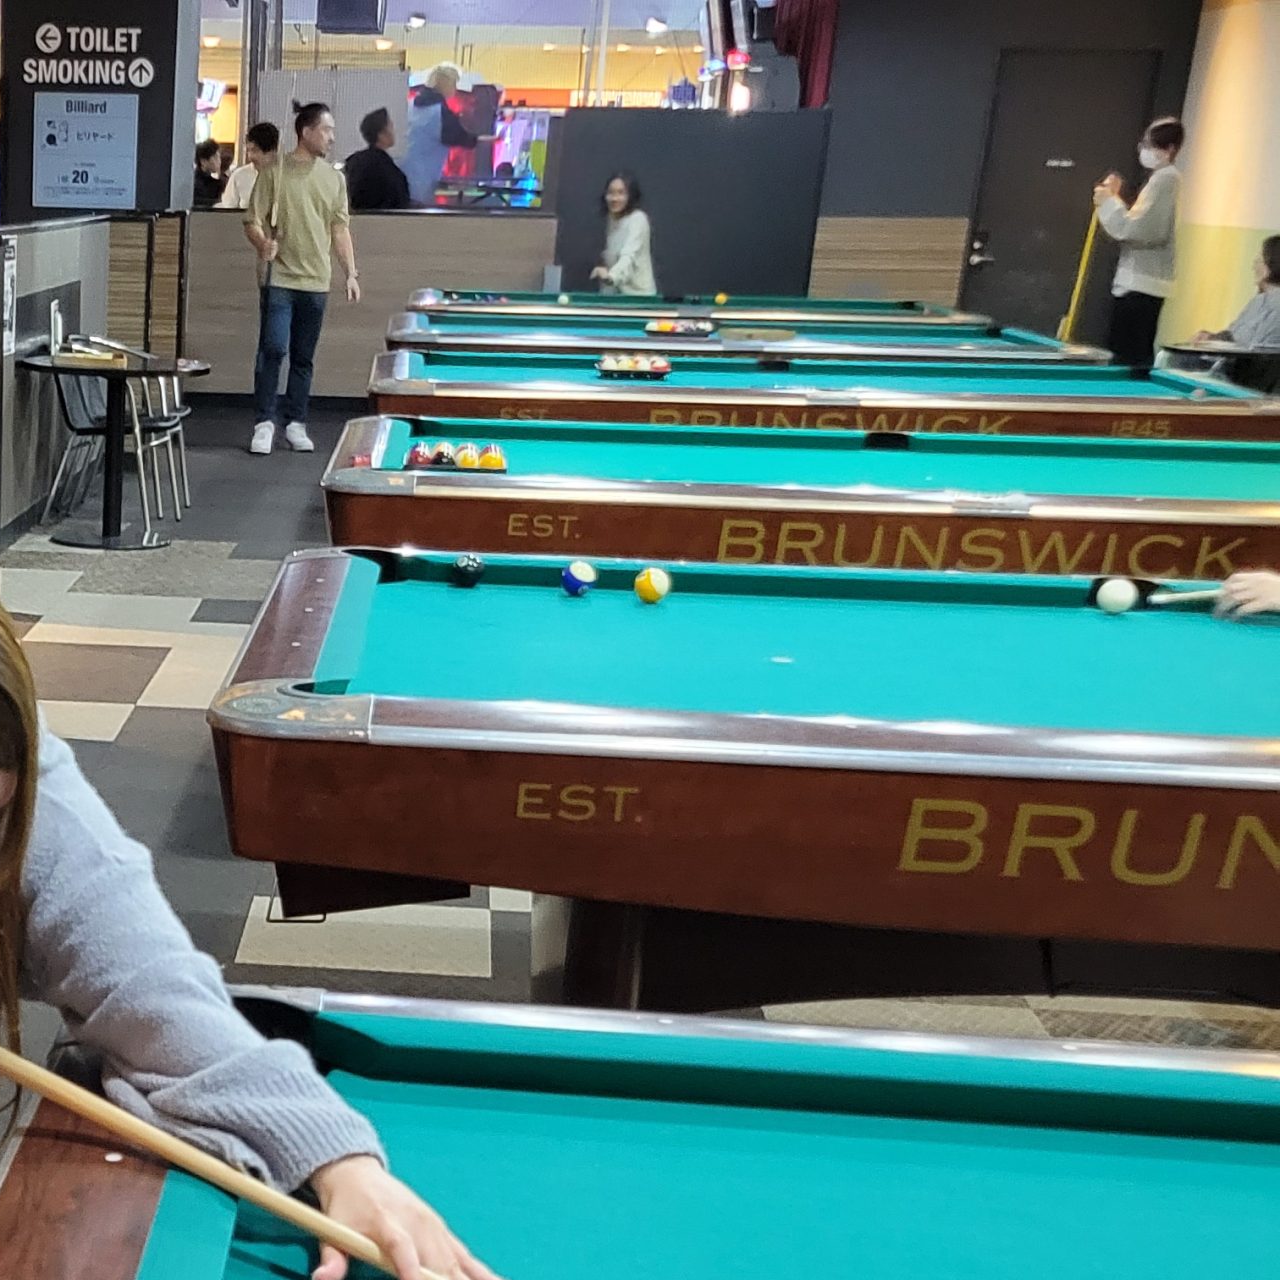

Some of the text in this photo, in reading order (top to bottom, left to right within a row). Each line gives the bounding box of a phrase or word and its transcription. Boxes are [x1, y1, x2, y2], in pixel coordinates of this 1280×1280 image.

[66, 26, 142, 53] TOILET
[23, 58, 126, 85] SMOKING
[65, 99, 107, 114] Billiard
[72, 170, 89, 184] 20
[507, 513, 581, 539] EST.
[716, 518, 1247, 579] BRUNSWICK
[516, 782, 642, 823] EST.
